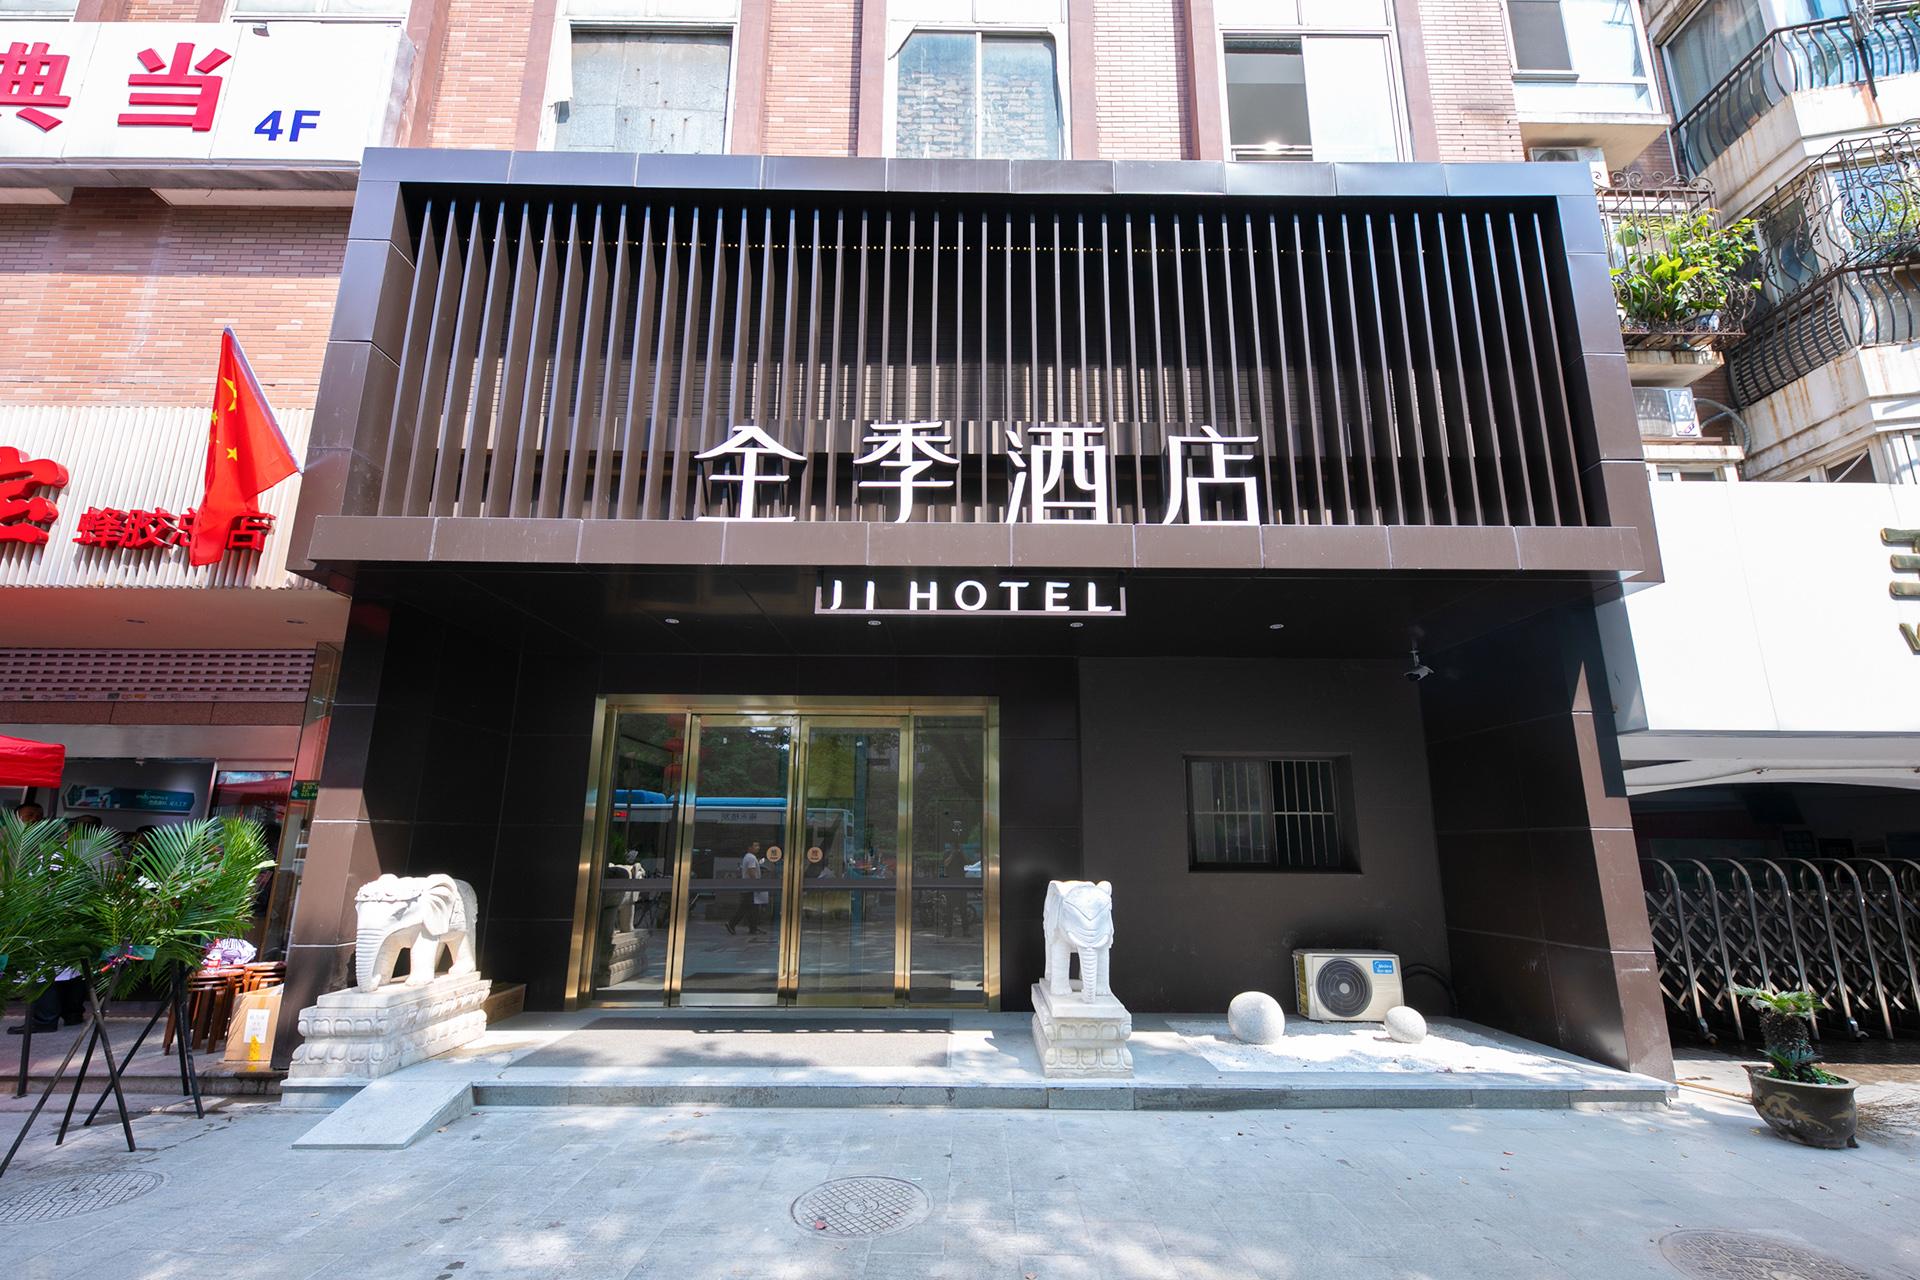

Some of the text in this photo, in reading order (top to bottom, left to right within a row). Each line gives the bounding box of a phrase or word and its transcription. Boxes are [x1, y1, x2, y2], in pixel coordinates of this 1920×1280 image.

[0, 42, 231, 132] 典当
[254, 109, 321, 142] 4F
[694, 420, 1260, 526] 全季酒店
[830, 580, 1113, 612] JI HOTEL
